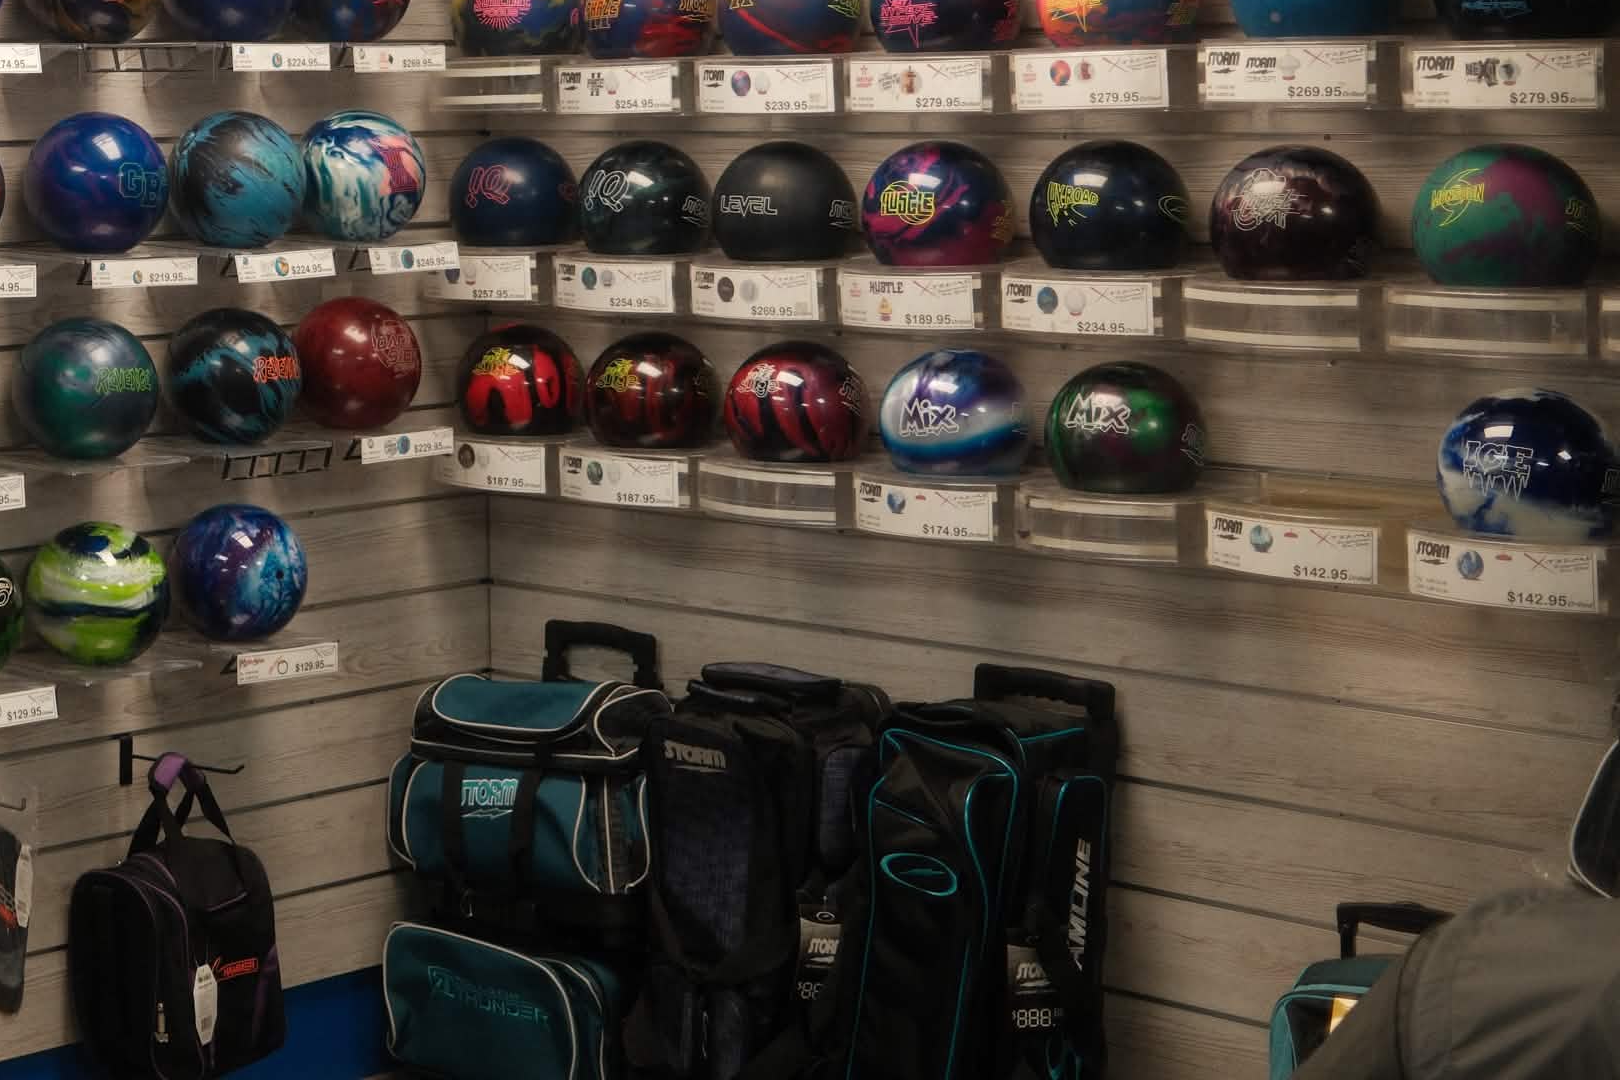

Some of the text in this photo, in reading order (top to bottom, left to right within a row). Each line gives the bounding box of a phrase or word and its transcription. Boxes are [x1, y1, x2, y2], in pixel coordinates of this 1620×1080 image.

[1206, 51, 1241, 66] STORM
[1244, 56, 1277, 70] STORM
[1415, 55, 1455, 72] STORM
[1089, 91, 1140, 103] $279.95
[1287, 85, 1343, 98] $269.95
[1509, 91, 1570, 105] $279.95
[615, 99, 654, 110] $254.95
[764, 100, 808, 111] $239.95
[915, 97, 960, 108] $279.95
[721, 195, 777, 216] LEVEL
[869, 281, 904, 294] HUSTLE
[610, 297, 648, 308] $254.95
[905, 314, 951, 326] $189.95
[1077, 322, 1125, 334] $234.95
[1463, 440, 1534, 482] ICE
[487, 476, 524, 488] $187.95
[616, 493, 656, 505] $187.95
[922, 524, 968, 537] $174.95
[1212, 518, 1243, 535] STORM
[1416, 542, 1451, 559] STORM
[1292, 565, 1348, 581] $142.95
[1507, 591, 1568, 607] $142.95
[295, 660, 325, 672] $129.95
[7, 707, 43, 720] $129.95
[664, 739, 727, 769] STORM
[460, 778, 519, 808] STORM
